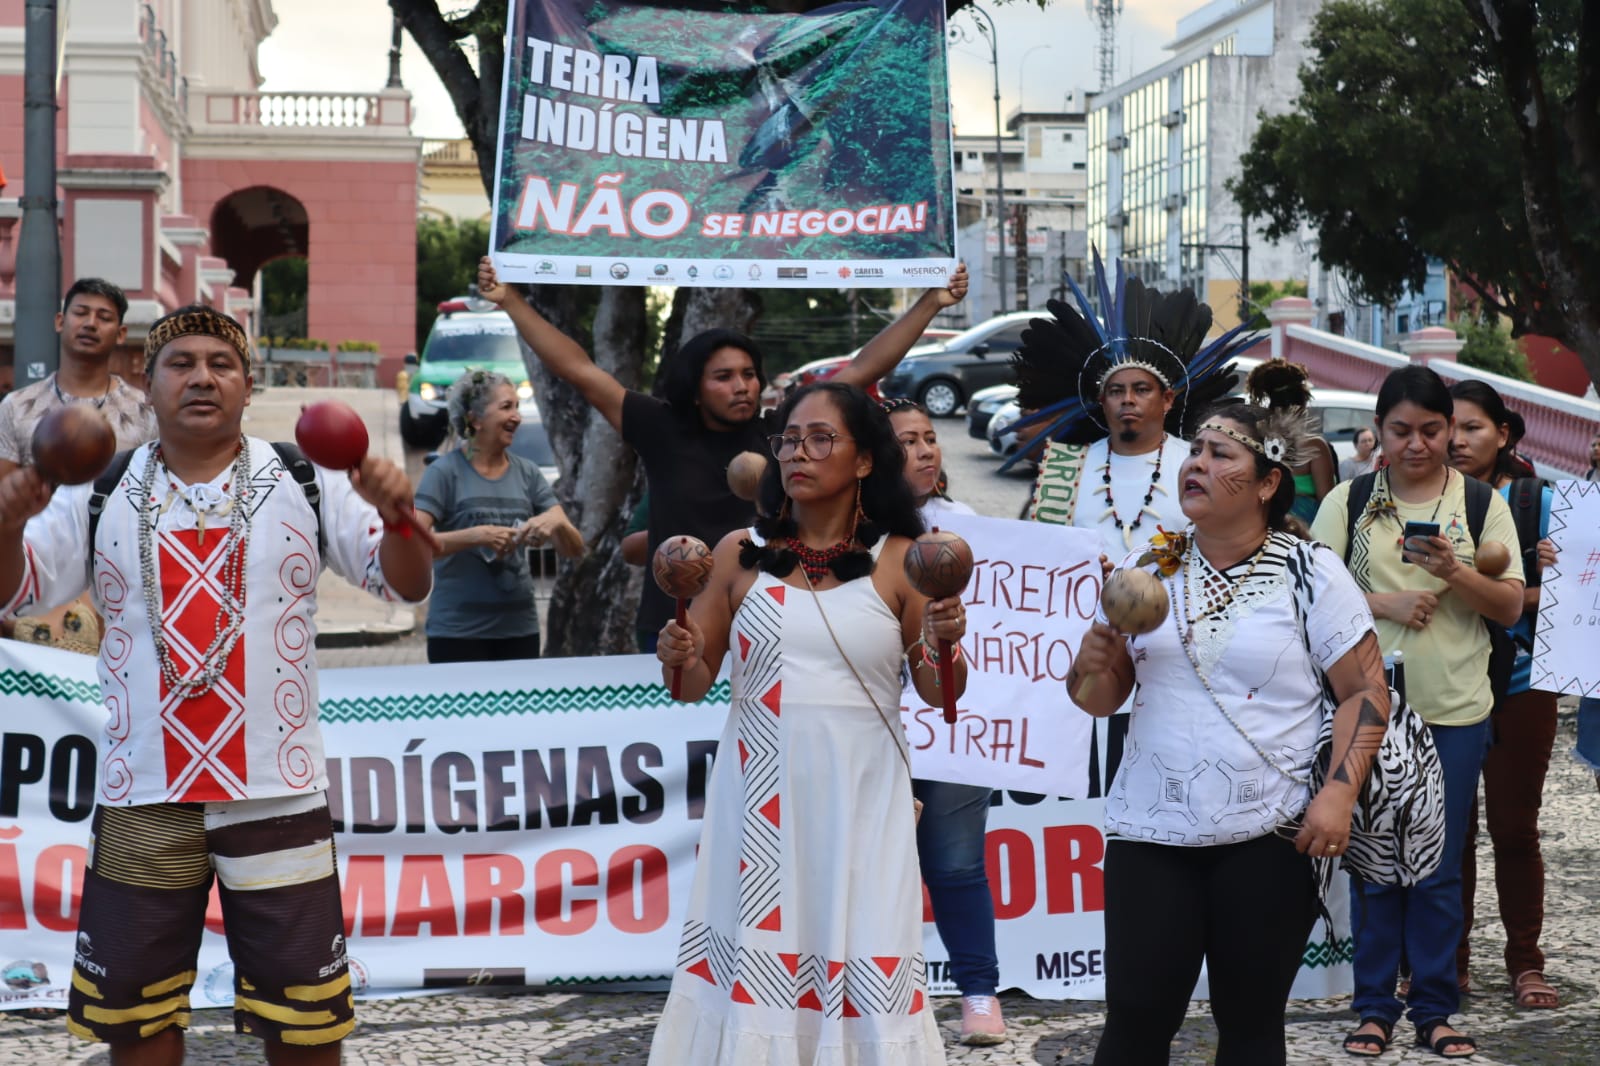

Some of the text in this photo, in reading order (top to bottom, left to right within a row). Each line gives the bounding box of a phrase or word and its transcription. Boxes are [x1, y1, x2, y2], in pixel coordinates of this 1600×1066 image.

[527, 37, 661, 103] TERRA
[521, 94, 728, 162] INDÍGENA
[515, 173, 928, 239] NÃO SE NEGOCIA!
[902, 266, 947, 276] MISEREOR
[965, 559, 1101, 620] IREITO
